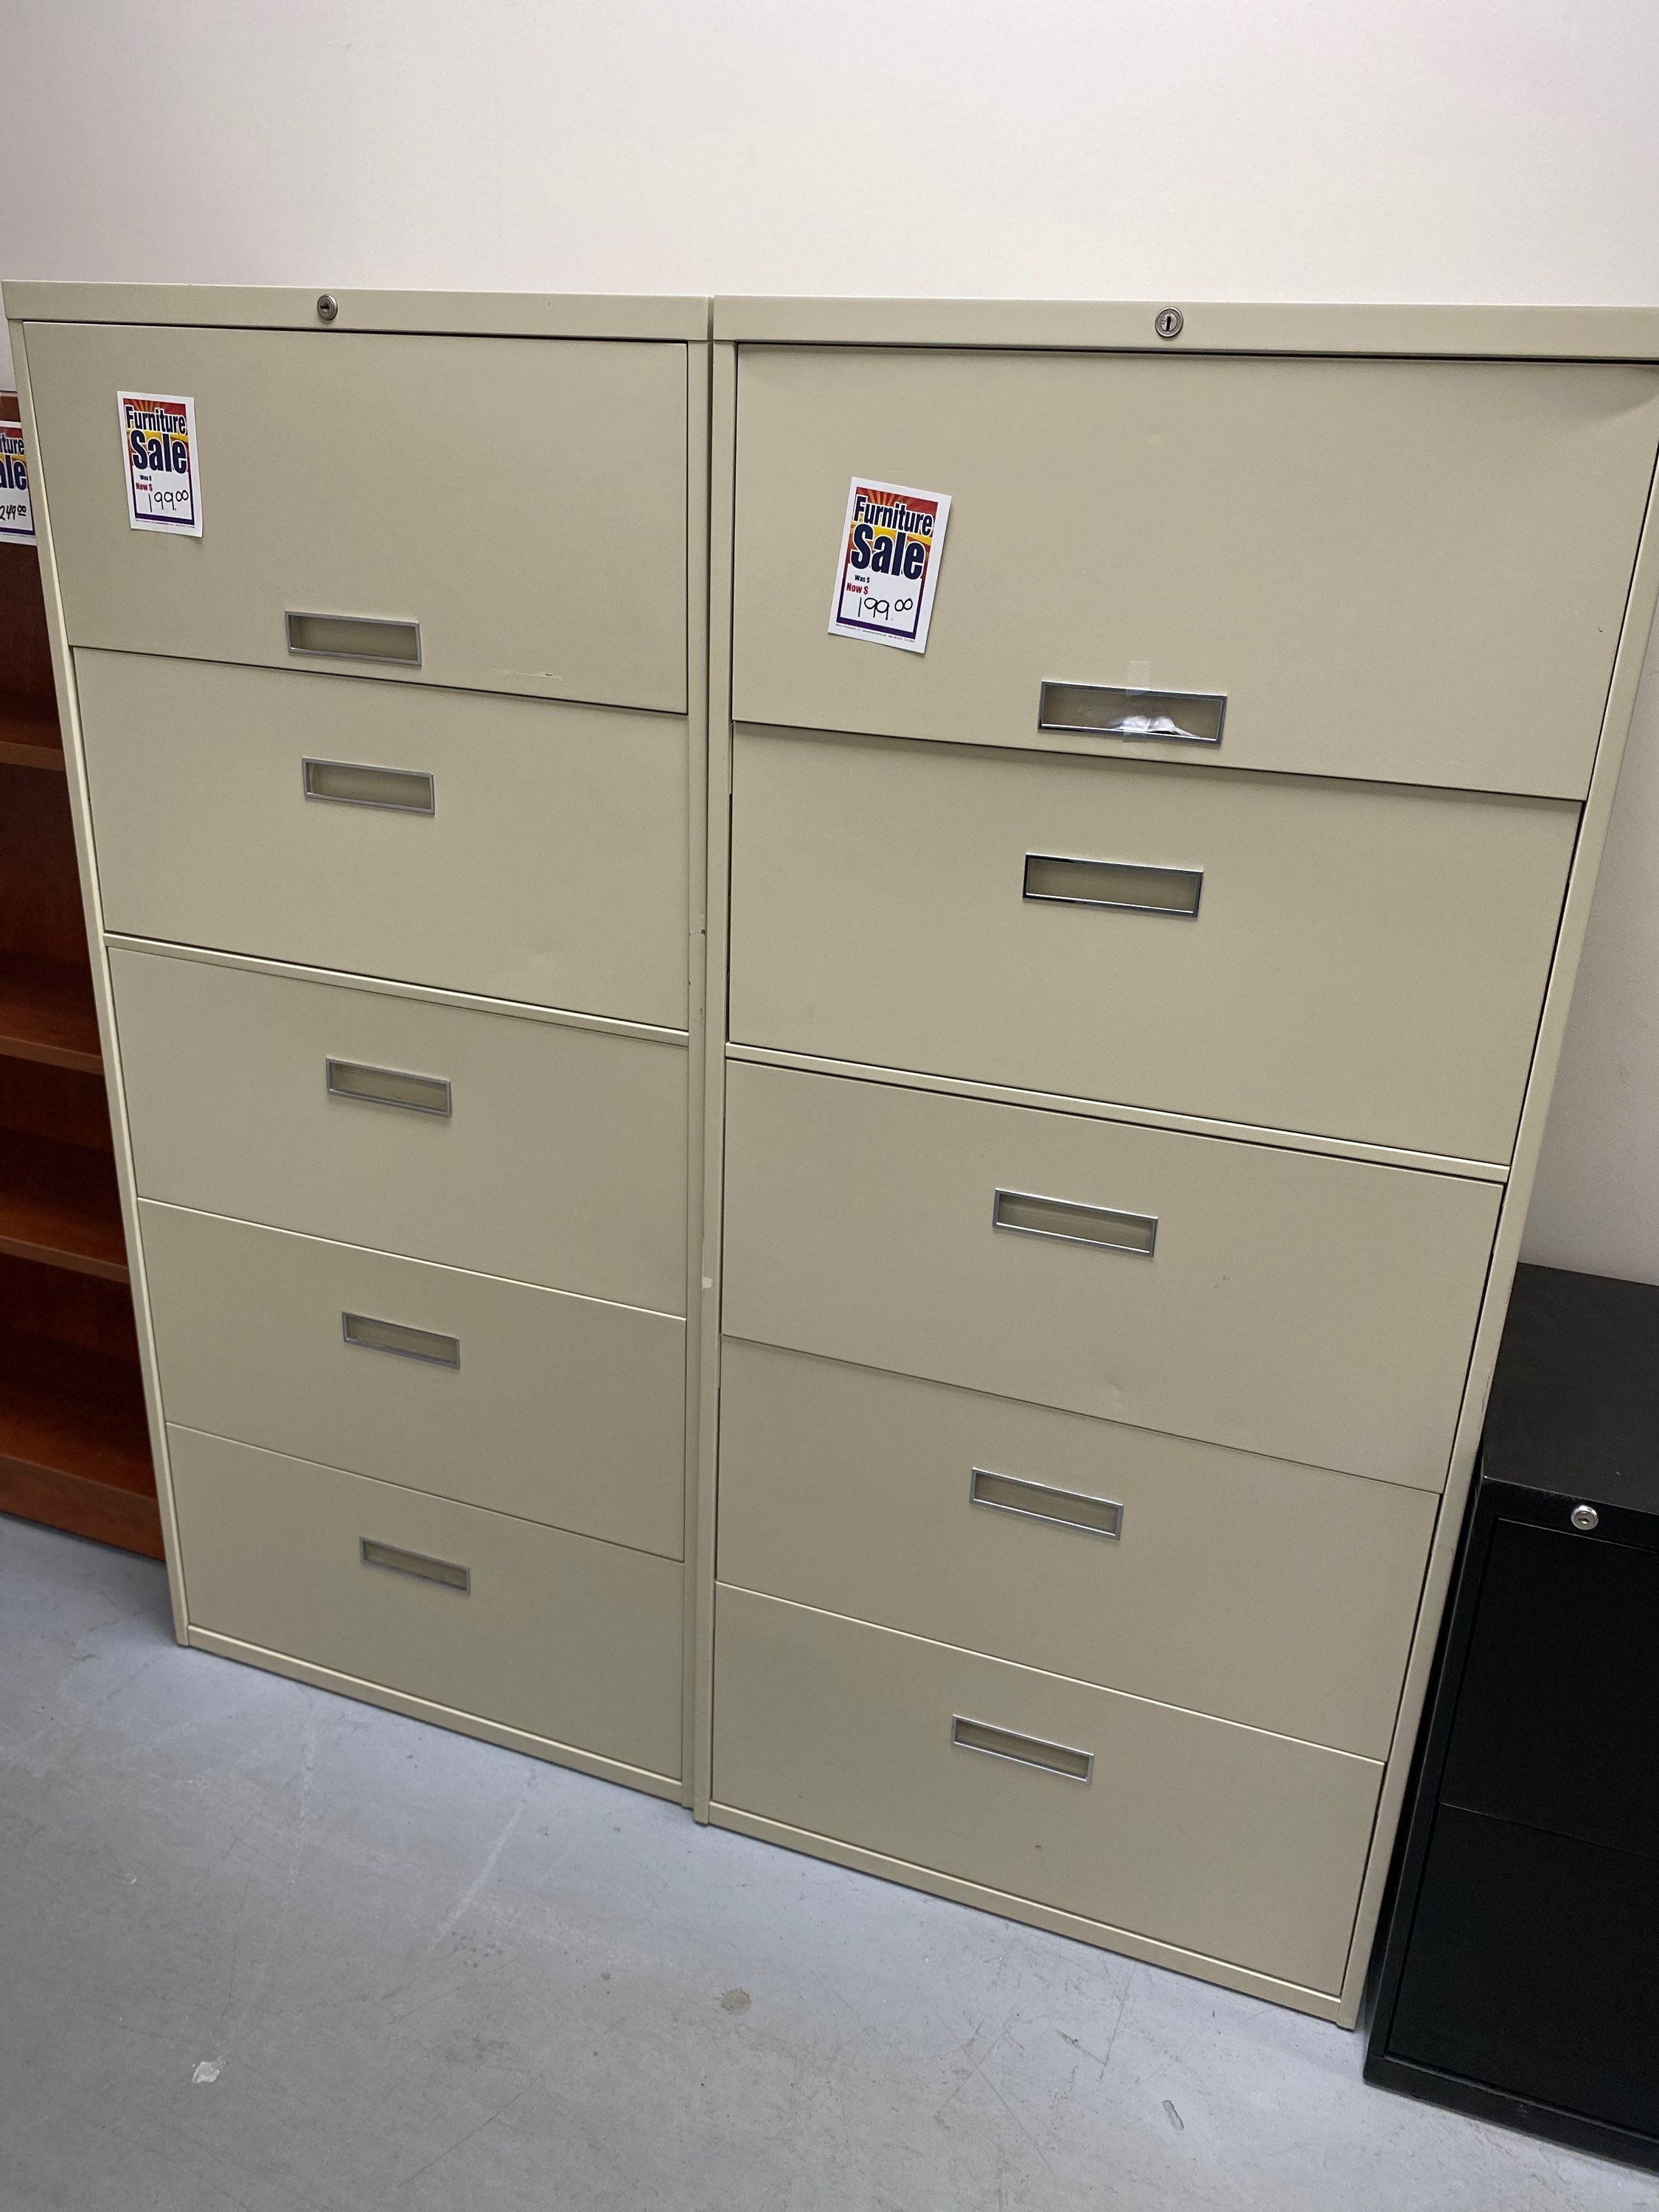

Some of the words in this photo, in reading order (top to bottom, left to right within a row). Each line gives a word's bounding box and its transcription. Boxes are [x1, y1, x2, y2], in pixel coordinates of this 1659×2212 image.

[125, 406, 187, 435] Furniture
[131, 429, 187, 474] Sale
[136, 482, 147, 491] Now
[853, 495, 933, 536] Furniture
[850, 523, 926, 580] Sale
[846, 582, 863, 594] Now
[863, 585, 869, 595] $
[855, 574, 866, 582] Was
